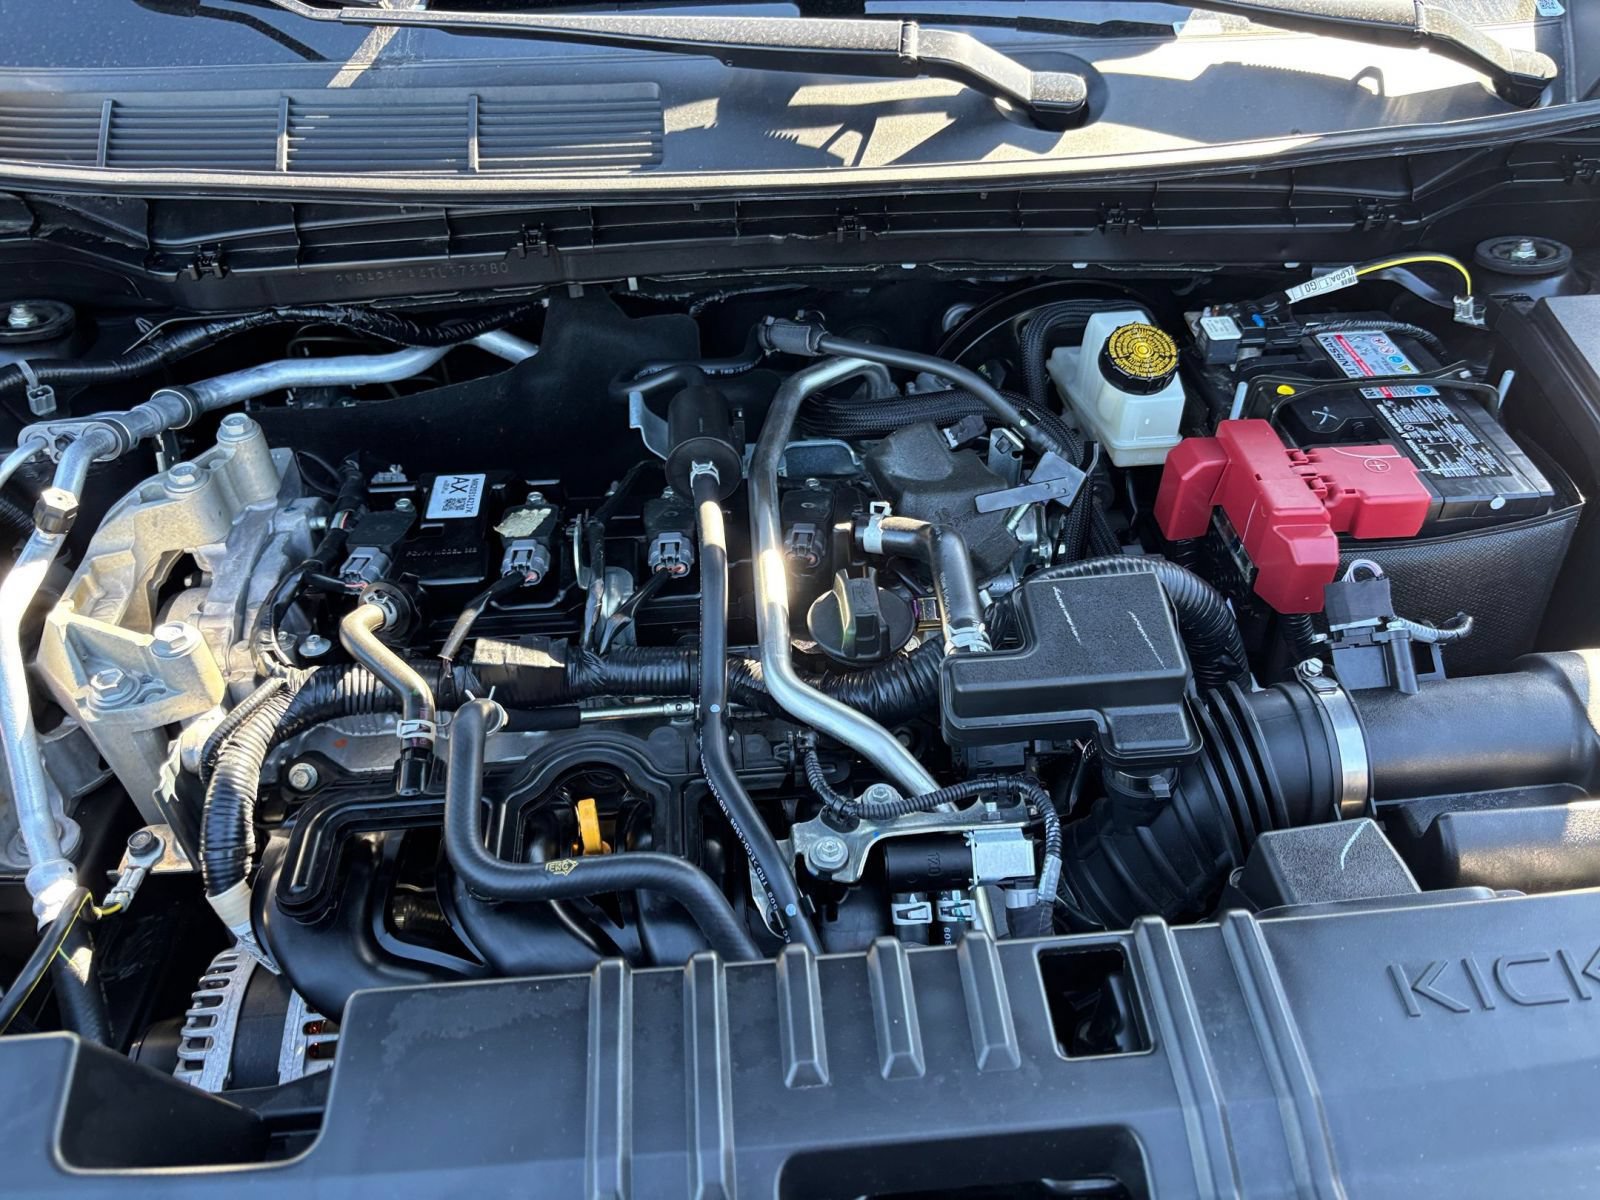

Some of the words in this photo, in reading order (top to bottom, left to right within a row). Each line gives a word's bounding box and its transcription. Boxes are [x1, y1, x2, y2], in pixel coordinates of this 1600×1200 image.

[1321, 336, 1349, 366] NISSAN
[449, 477, 470, 494] AX
[548, 861, 569, 872] ENG
